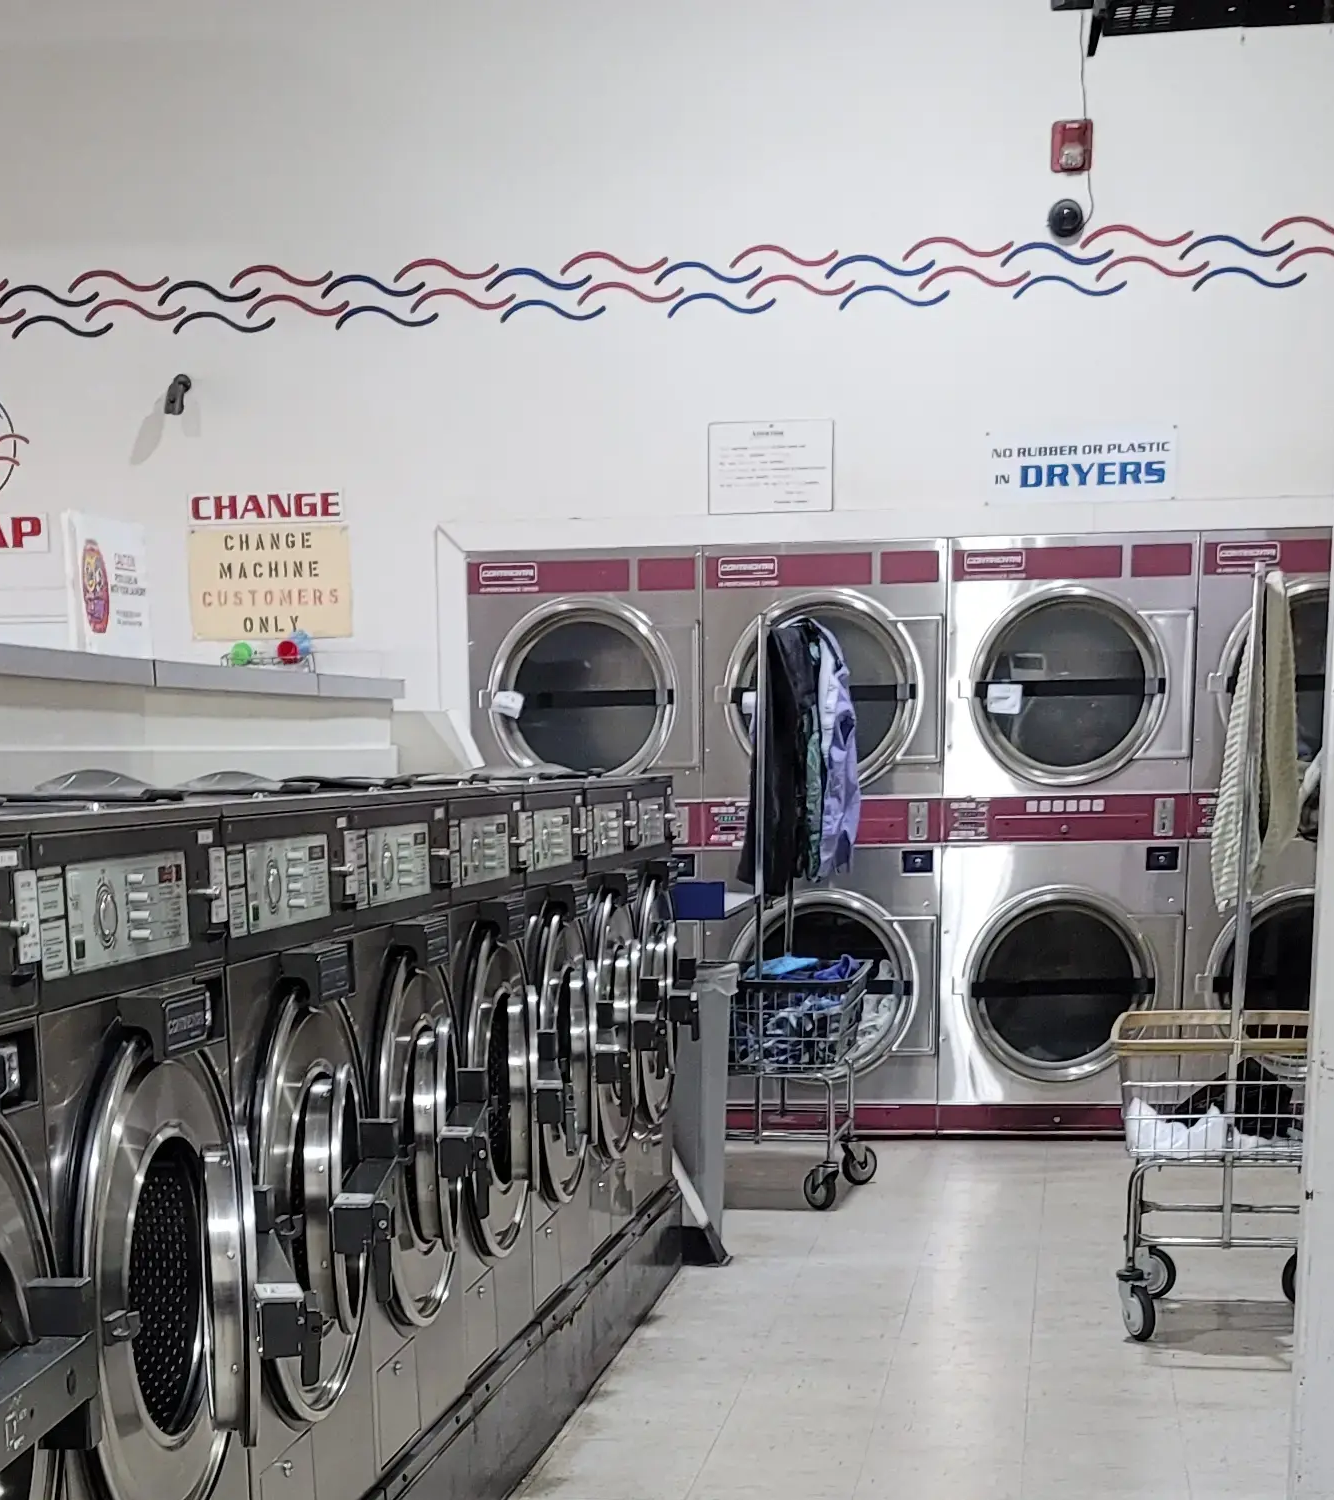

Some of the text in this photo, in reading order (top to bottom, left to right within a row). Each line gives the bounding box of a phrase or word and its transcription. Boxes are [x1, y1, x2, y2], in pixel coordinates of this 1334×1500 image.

[991, 441, 1172, 459] NO RUBBER OR PLASTIC
[994, 460, 1167, 488] IN DRYERS
[191, 491, 341, 521] CHANGE
[223, 531, 313, 552] CHANGE
[218, 560, 320, 580] MACHINE
[201, 588, 340, 608] CUSTOMERS
[242, 615, 300, 634] ONLY
